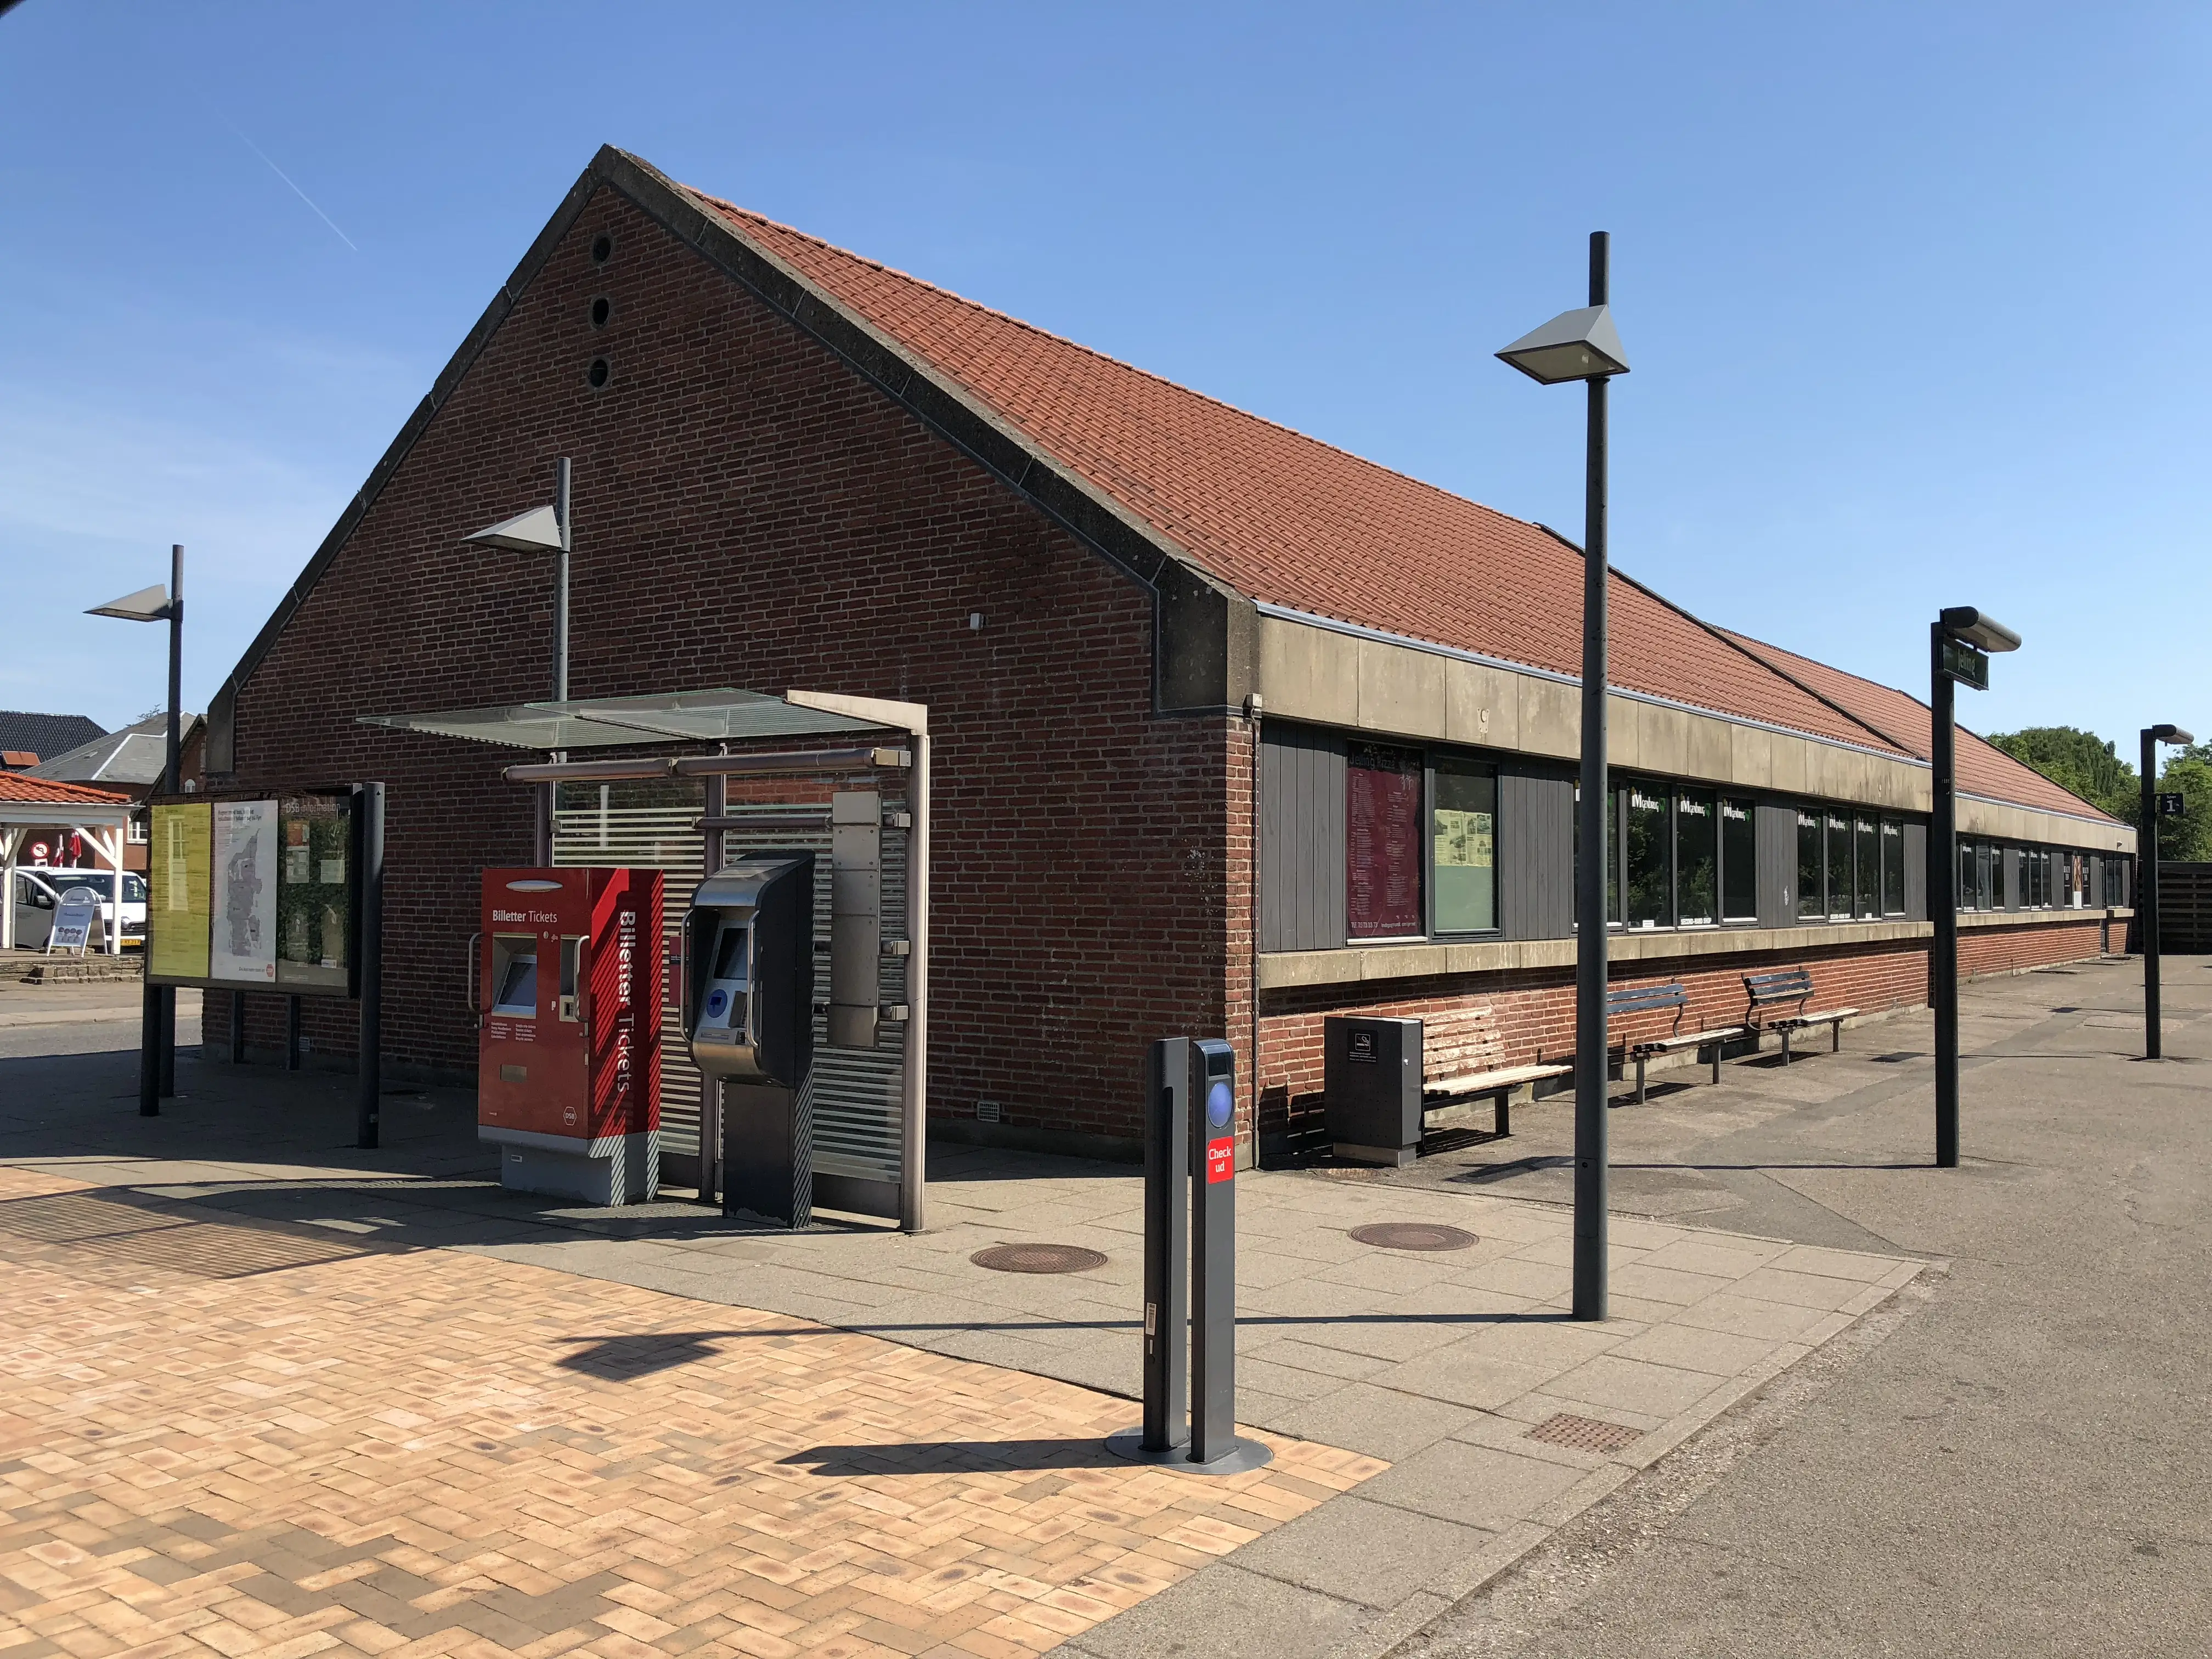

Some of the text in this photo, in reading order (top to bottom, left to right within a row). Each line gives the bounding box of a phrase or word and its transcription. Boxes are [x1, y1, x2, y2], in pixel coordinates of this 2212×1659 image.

[1957, 648, 1976, 679] Jelling
[2166, 800, 2176, 812] 1
[493, 910, 558, 923] Billetter Tickets
[617, 911, 636, 1093] Billetter Tickets
[1209, 1146, 1232, 1160] Check
[1215, 1160, 1226, 1173] ud
